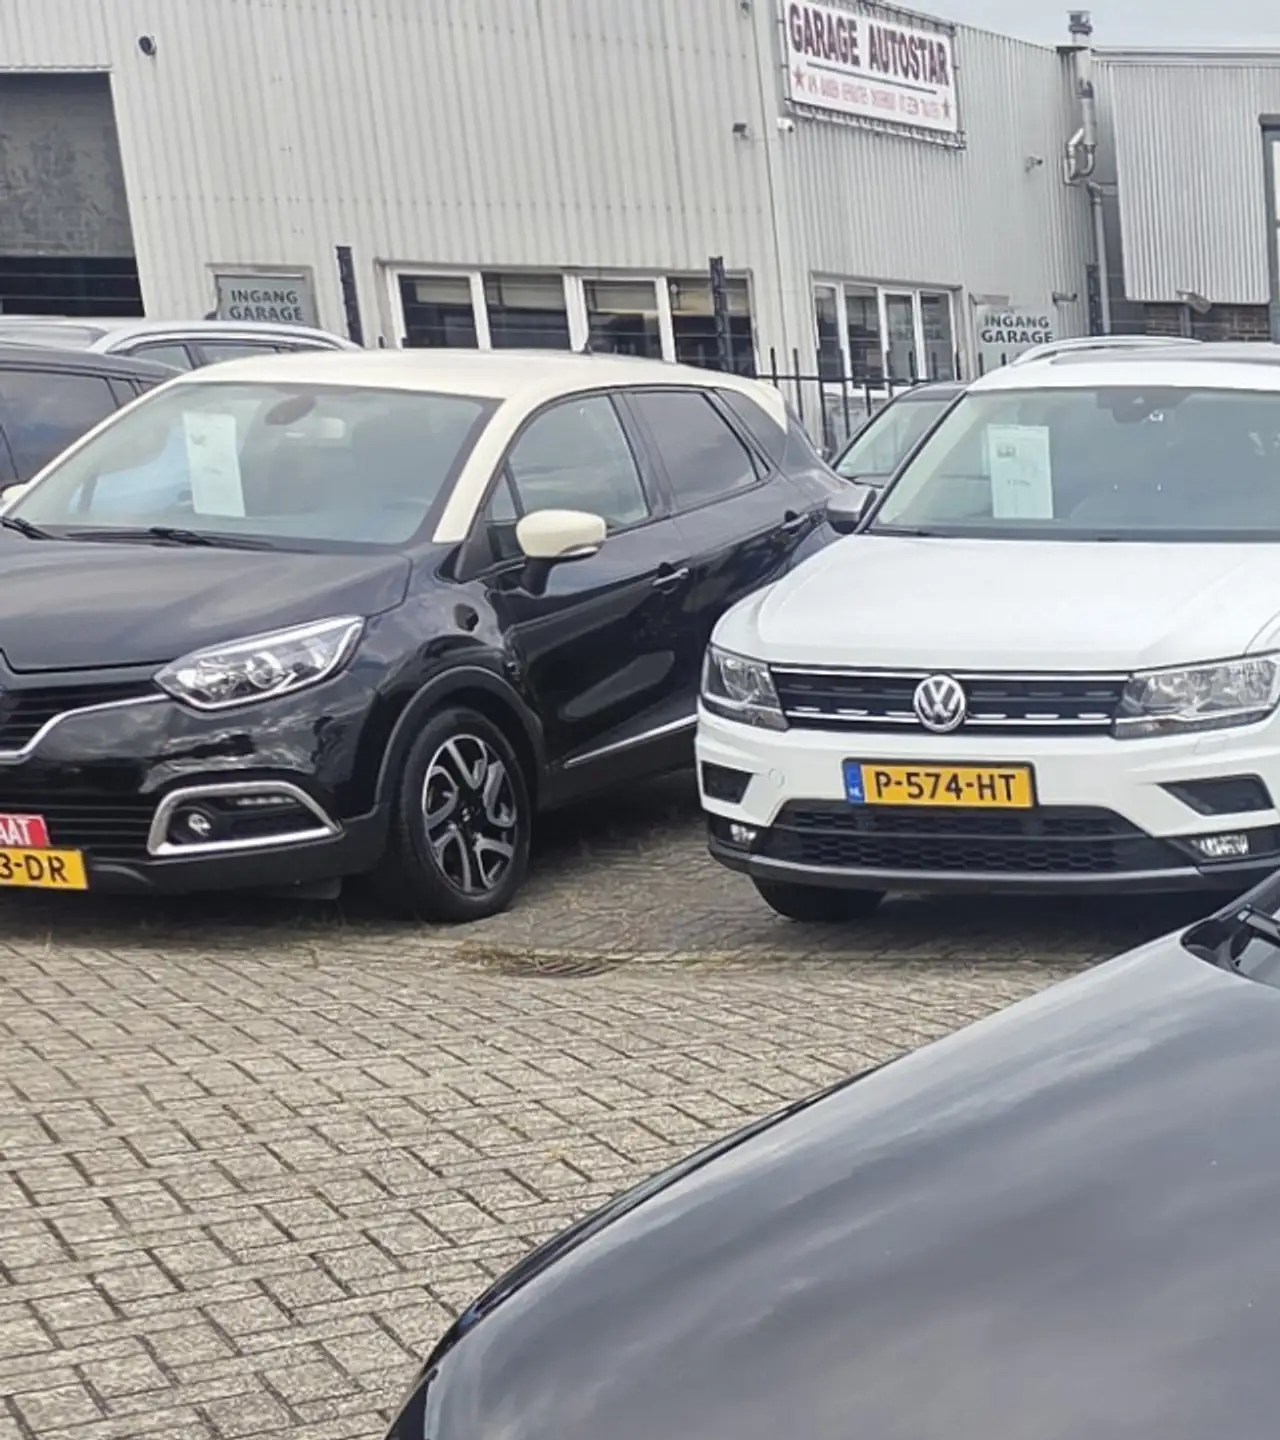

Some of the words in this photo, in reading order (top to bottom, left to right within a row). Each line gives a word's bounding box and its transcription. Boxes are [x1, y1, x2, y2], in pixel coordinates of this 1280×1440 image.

[789, 3, 861, 67] GARAGE
[868, 24, 950, 87] AUTOSTAR
[231, 290, 299, 304] INGANG
[229, 306, 304, 322] GARAGE
[984, 315, 1049, 329] INGANG
[981, 330, 1056, 344] GARAGE
[874, 770, 1016, 802] P-574-HT
